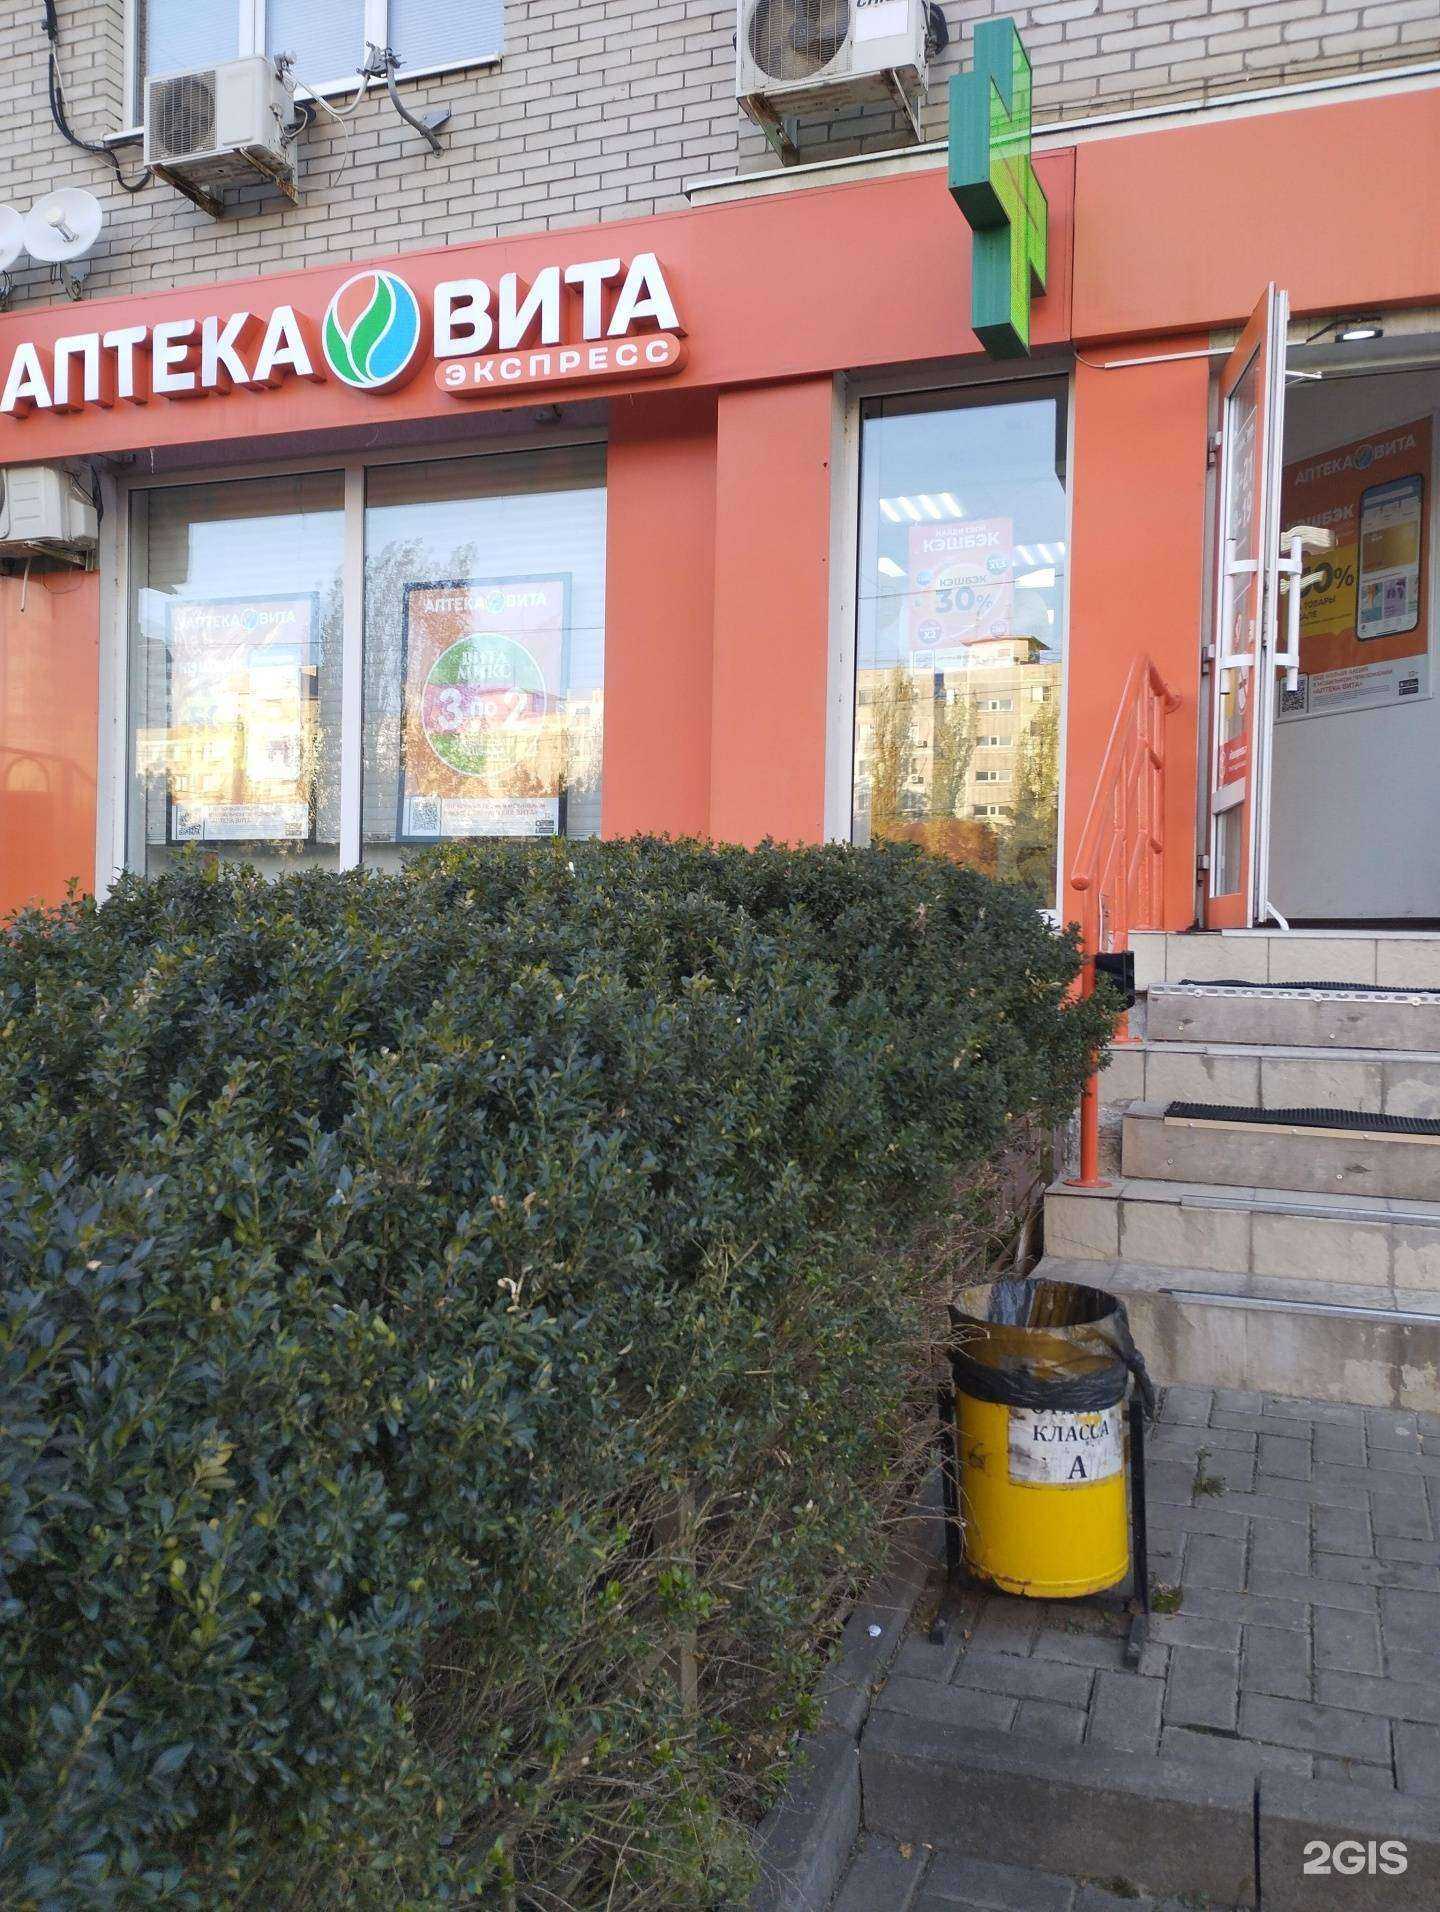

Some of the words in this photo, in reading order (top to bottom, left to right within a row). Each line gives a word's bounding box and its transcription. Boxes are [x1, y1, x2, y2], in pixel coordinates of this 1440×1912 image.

[0, 304, 313, 413] АПТЕКА
[432, 252, 681, 358] ВИТА
[444, 339, 671, 387] ЭКСПРЕСС
[1295, 453, 1353, 486] АПТЕКА
[1374, 434, 1416, 460] ВИТА
[923, 531, 1000, 553] КЭШБЭК
[438, 687, 463, 730] 3
[502, 687, 529, 731] 2
[1033, 1420, 1109, 1442] КЛАССА
[1066, 1455, 1088, 1480] А
